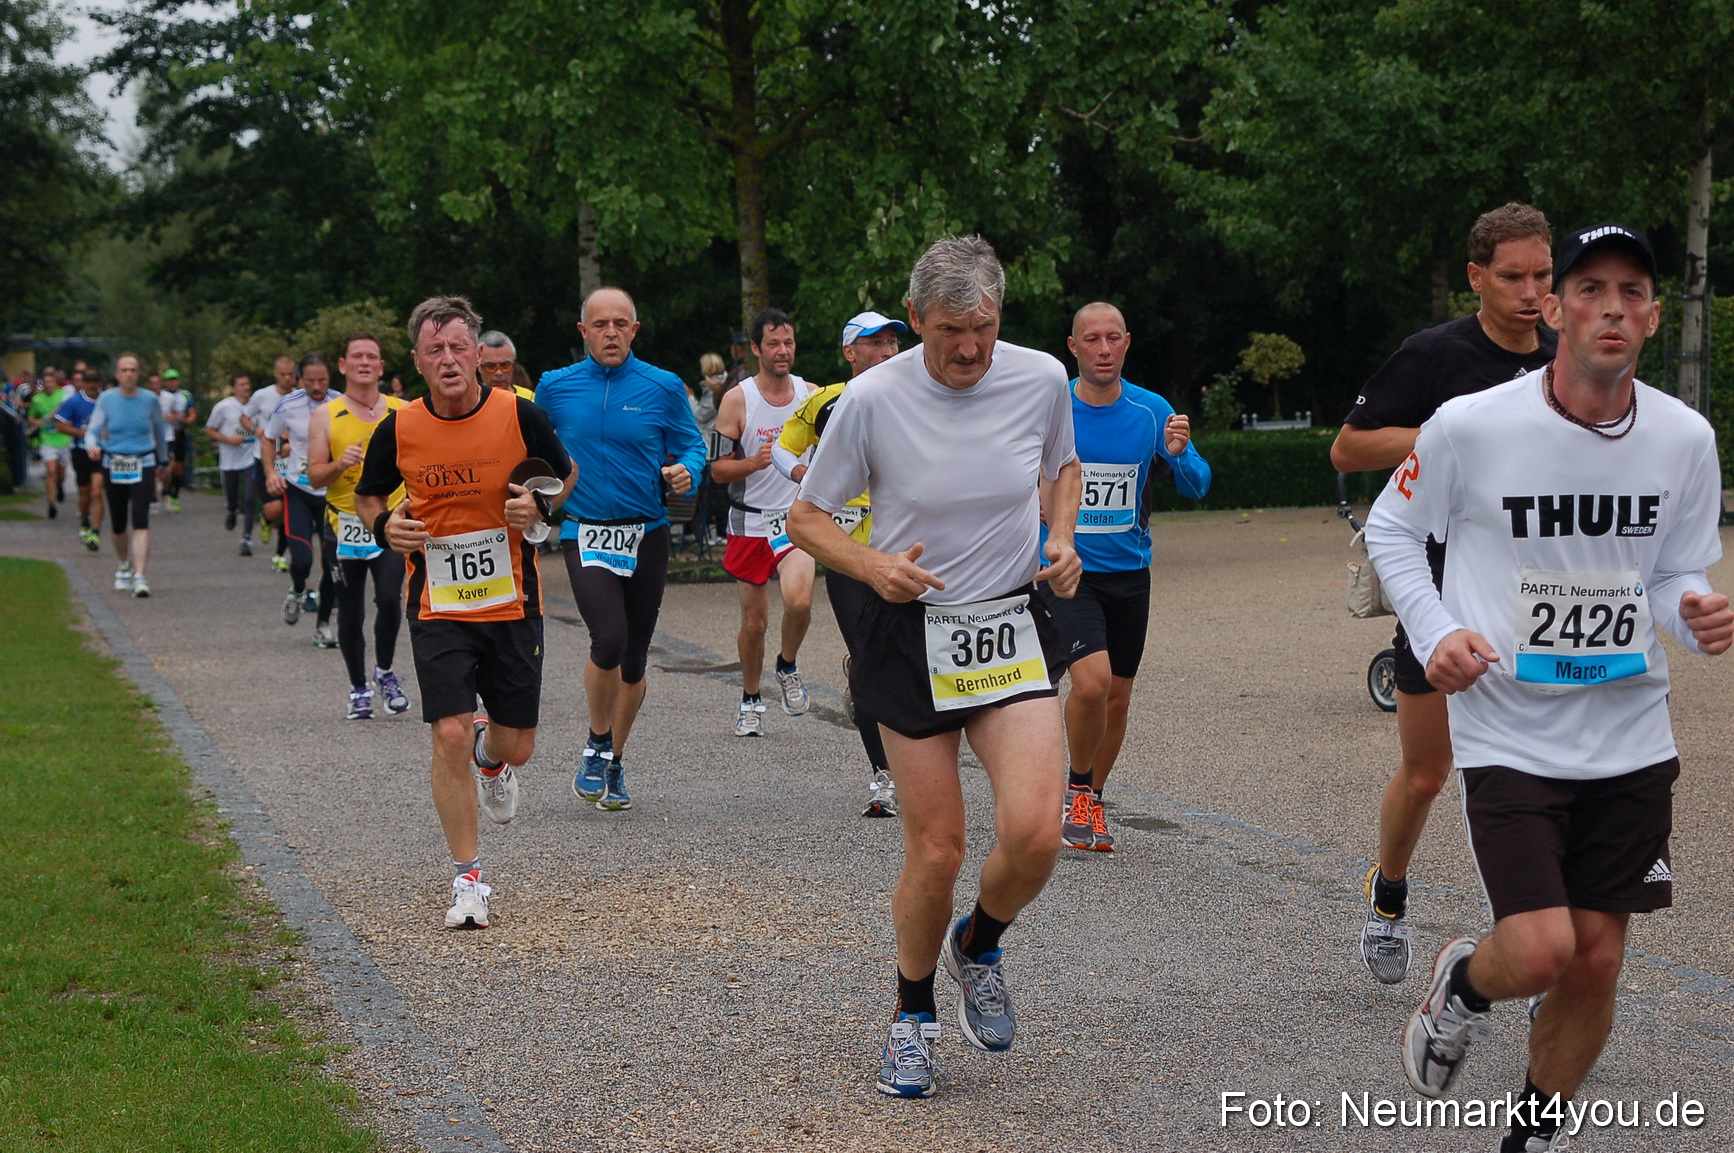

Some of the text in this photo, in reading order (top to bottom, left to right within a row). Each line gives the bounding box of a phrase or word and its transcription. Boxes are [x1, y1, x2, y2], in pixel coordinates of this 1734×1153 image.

[1579, 226, 1636, 244] THU
[425, 468, 481, 488] OEXL
[1090, 470, 1126, 478] Neumarkt
[1394, 452, 1420, 501] 2
[453, 489, 481, 498] VISION
[1080, 481, 1128, 506] 571
[1083, 513, 1114, 523] Stefan
[1502, 495, 1660, 538] THULE
[344, 525, 375, 543] 225
[1621, 526, 1654, 535] SWEDEN
[426, 537, 494, 551] PARTL Neumarkt
[585, 528, 637, 554] 2204
[444, 549, 495, 581] 165
[457, 586, 489, 601] Xaver
[1520, 582, 1631, 598] PARTL Neumarkt
[927, 608, 1011, 624] PARTL Neumarkt
[1528, 602, 1638, 649] 2426
[951, 622, 1016, 667] 360
[933, 667, 938, 675] B
[1555, 661, 1608, 680] Marco
[955, 668, 1022, 692] Bernhard
[1643, 871, 1672, 883] adida
